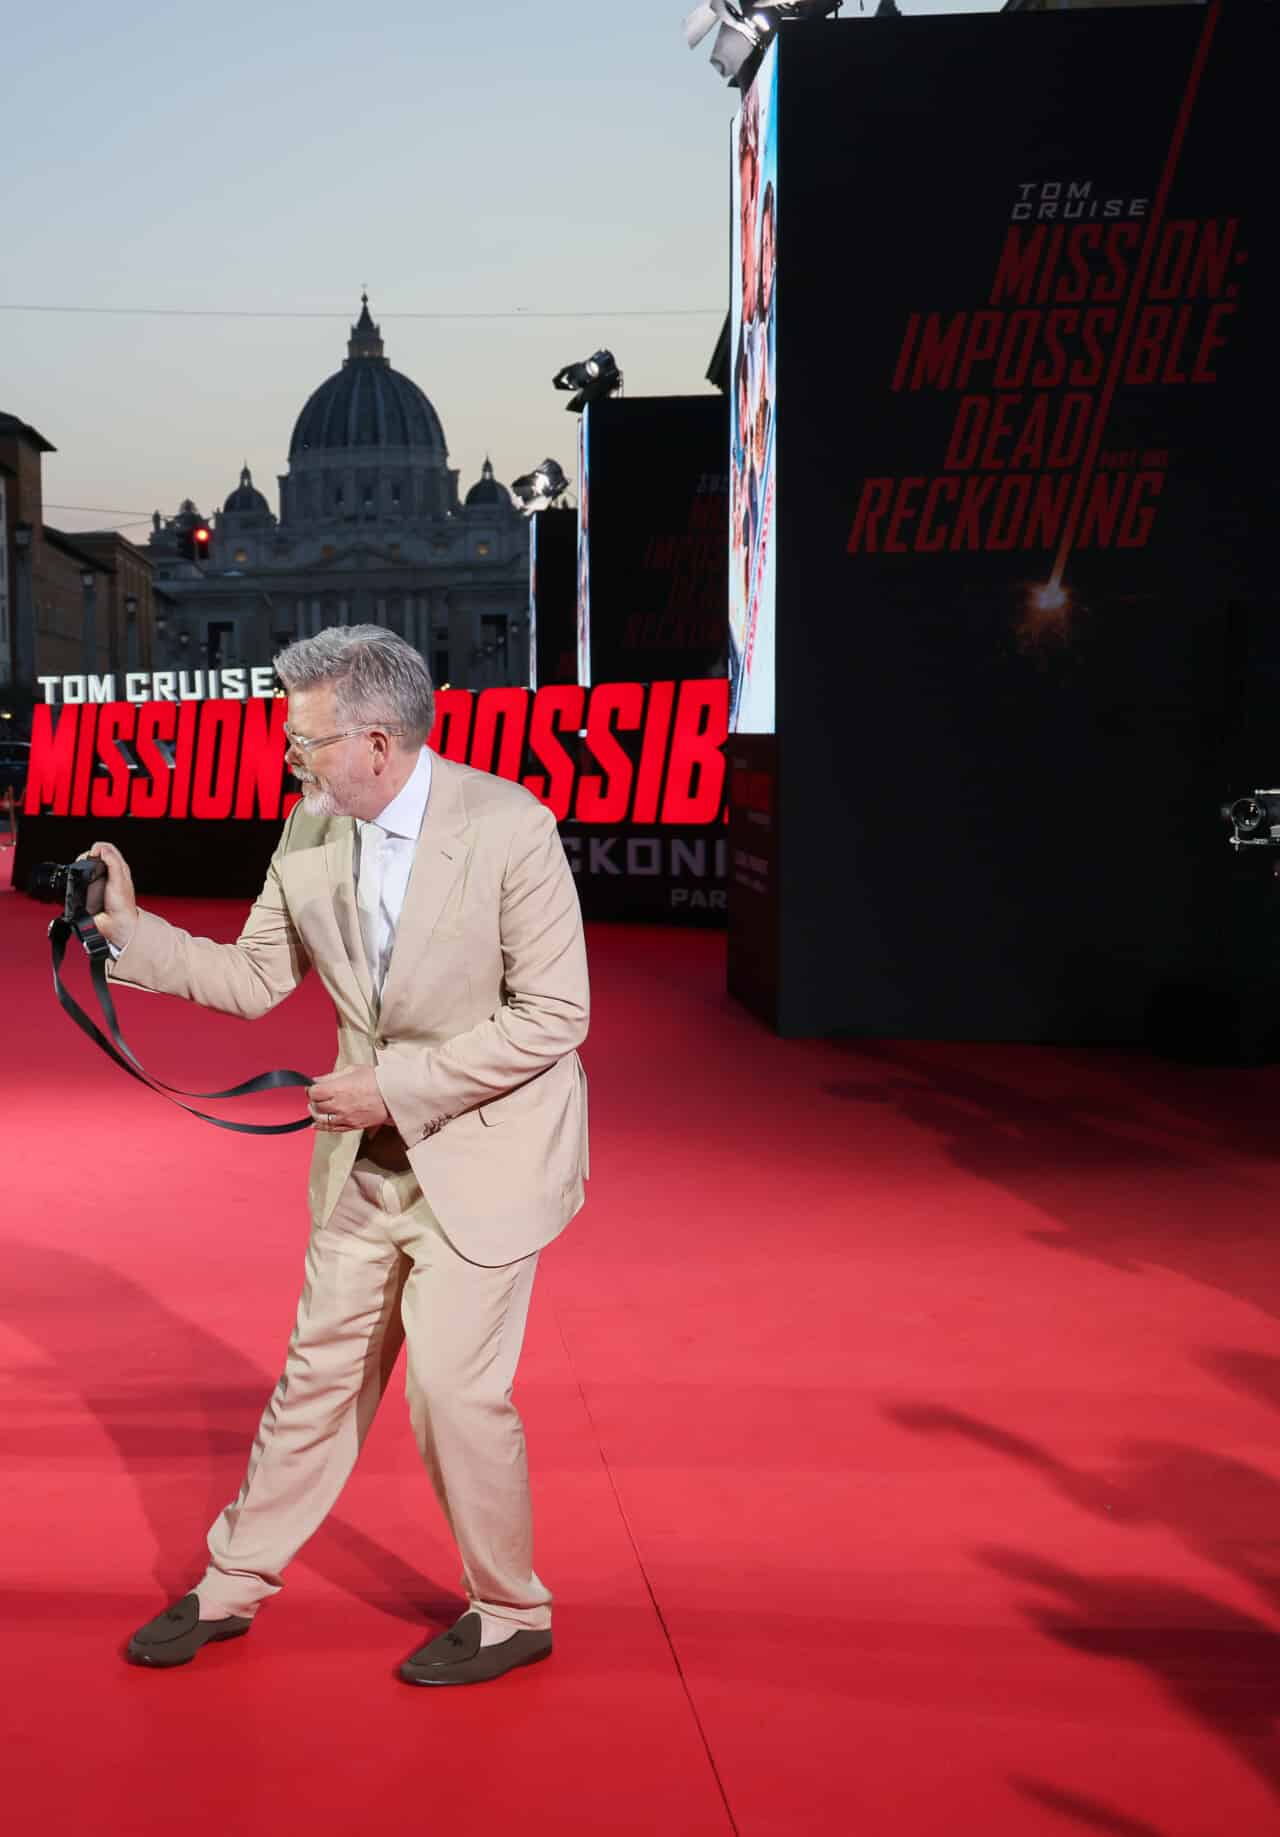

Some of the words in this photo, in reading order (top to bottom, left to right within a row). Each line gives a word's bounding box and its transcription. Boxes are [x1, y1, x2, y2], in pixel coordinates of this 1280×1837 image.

[1011, 199, 1149, 220] CRUISE
[1017, 181, 1093, 200] TOM
[989, 217, 1248, 304] MISSION:
[891, 304, 1237, 391] IMPOSSIBLE
[943, 392, 1094, 470] DEAD
[847, 471, 1164, 553] RECKONING
[37, 674, 116, 704] TOM
[125, 667, 276, 703] CRUISE
[426, 677, 730, 826] POSSIB
